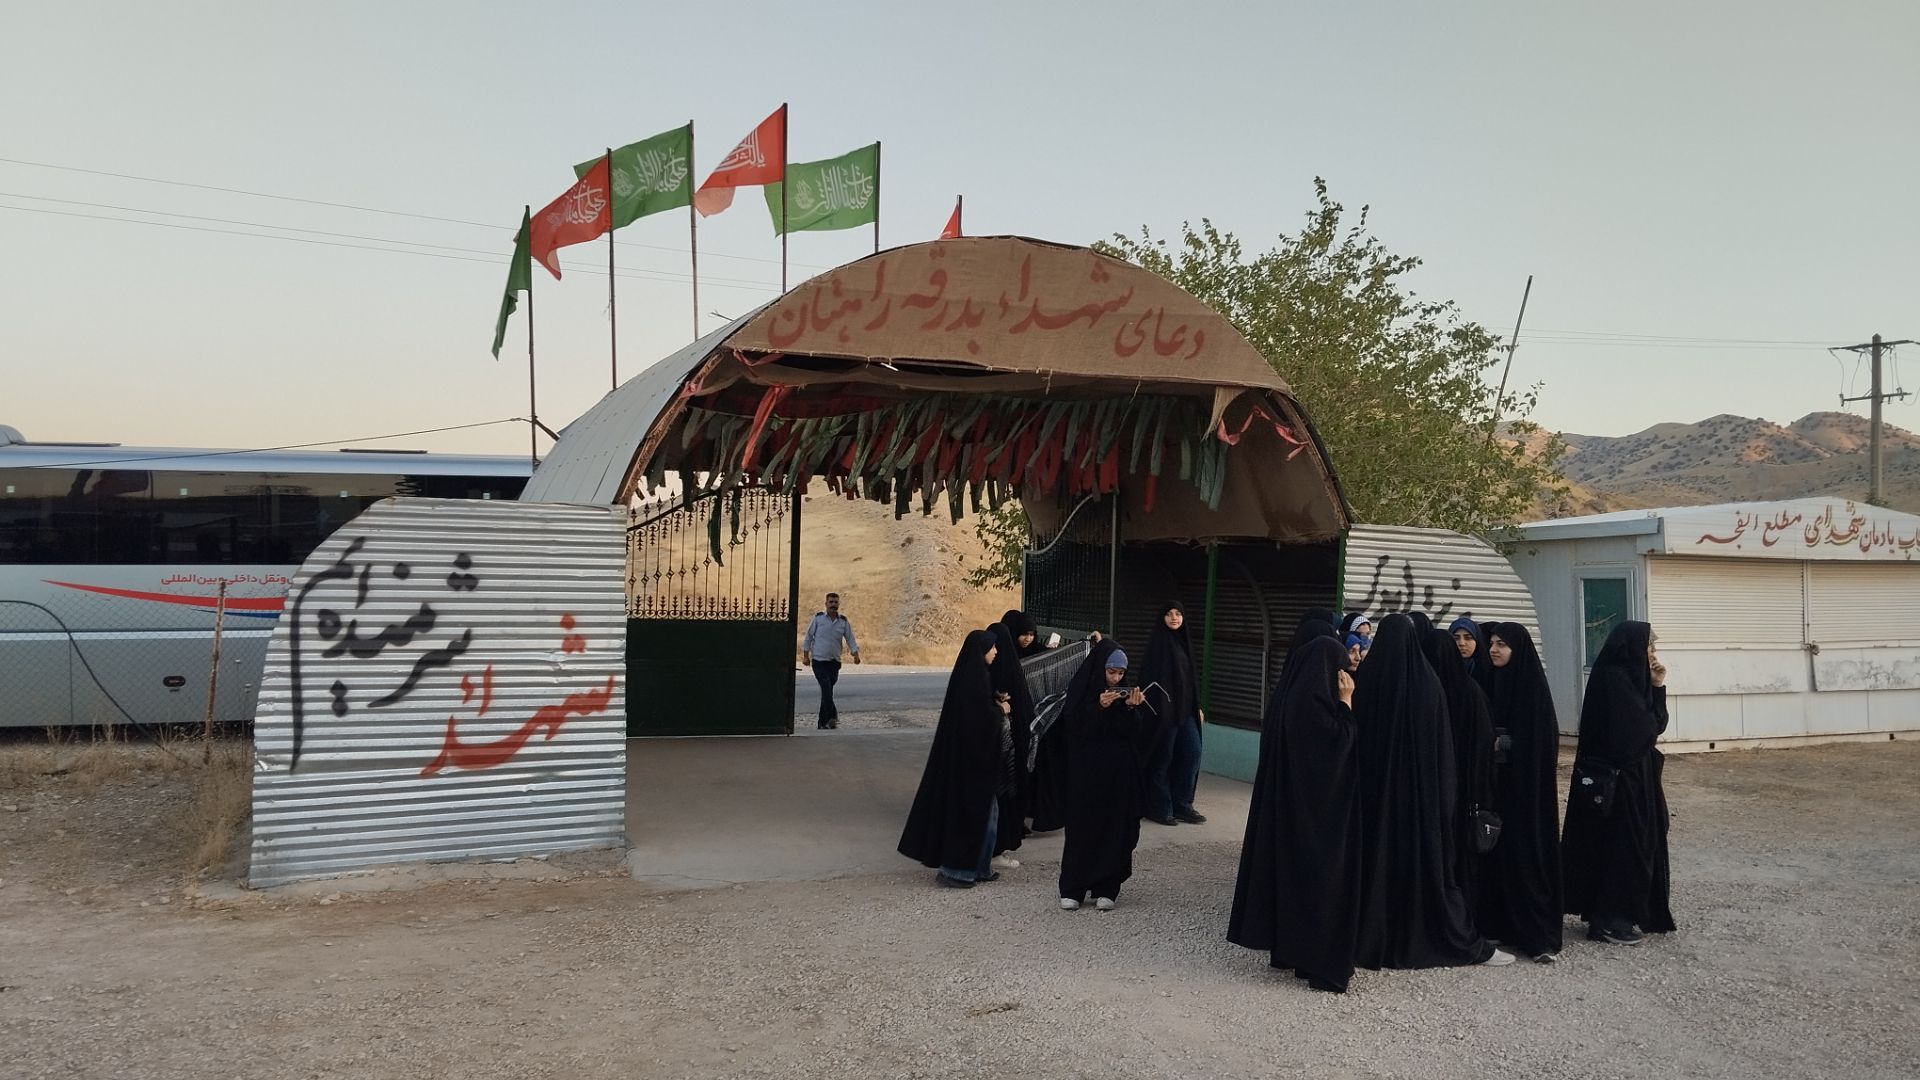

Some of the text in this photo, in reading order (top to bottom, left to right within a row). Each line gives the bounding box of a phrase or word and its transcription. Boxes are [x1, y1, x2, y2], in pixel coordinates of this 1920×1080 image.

[900, 245, 986, 356] بدرقه
[1113, 306, 1206, 361] دعای
[1696, 509, 1759, 550] الفجر
[1762, 508, 1802, 548] مطلع
[1804, 500, 1866, 547] شهدای
[1859, 520, 1894, 553] یادمان
[161, 573, 196, 586] المللی
[197, 575, 217, 586] بین
[289, 536, 479, 775] شرمنده ایم
